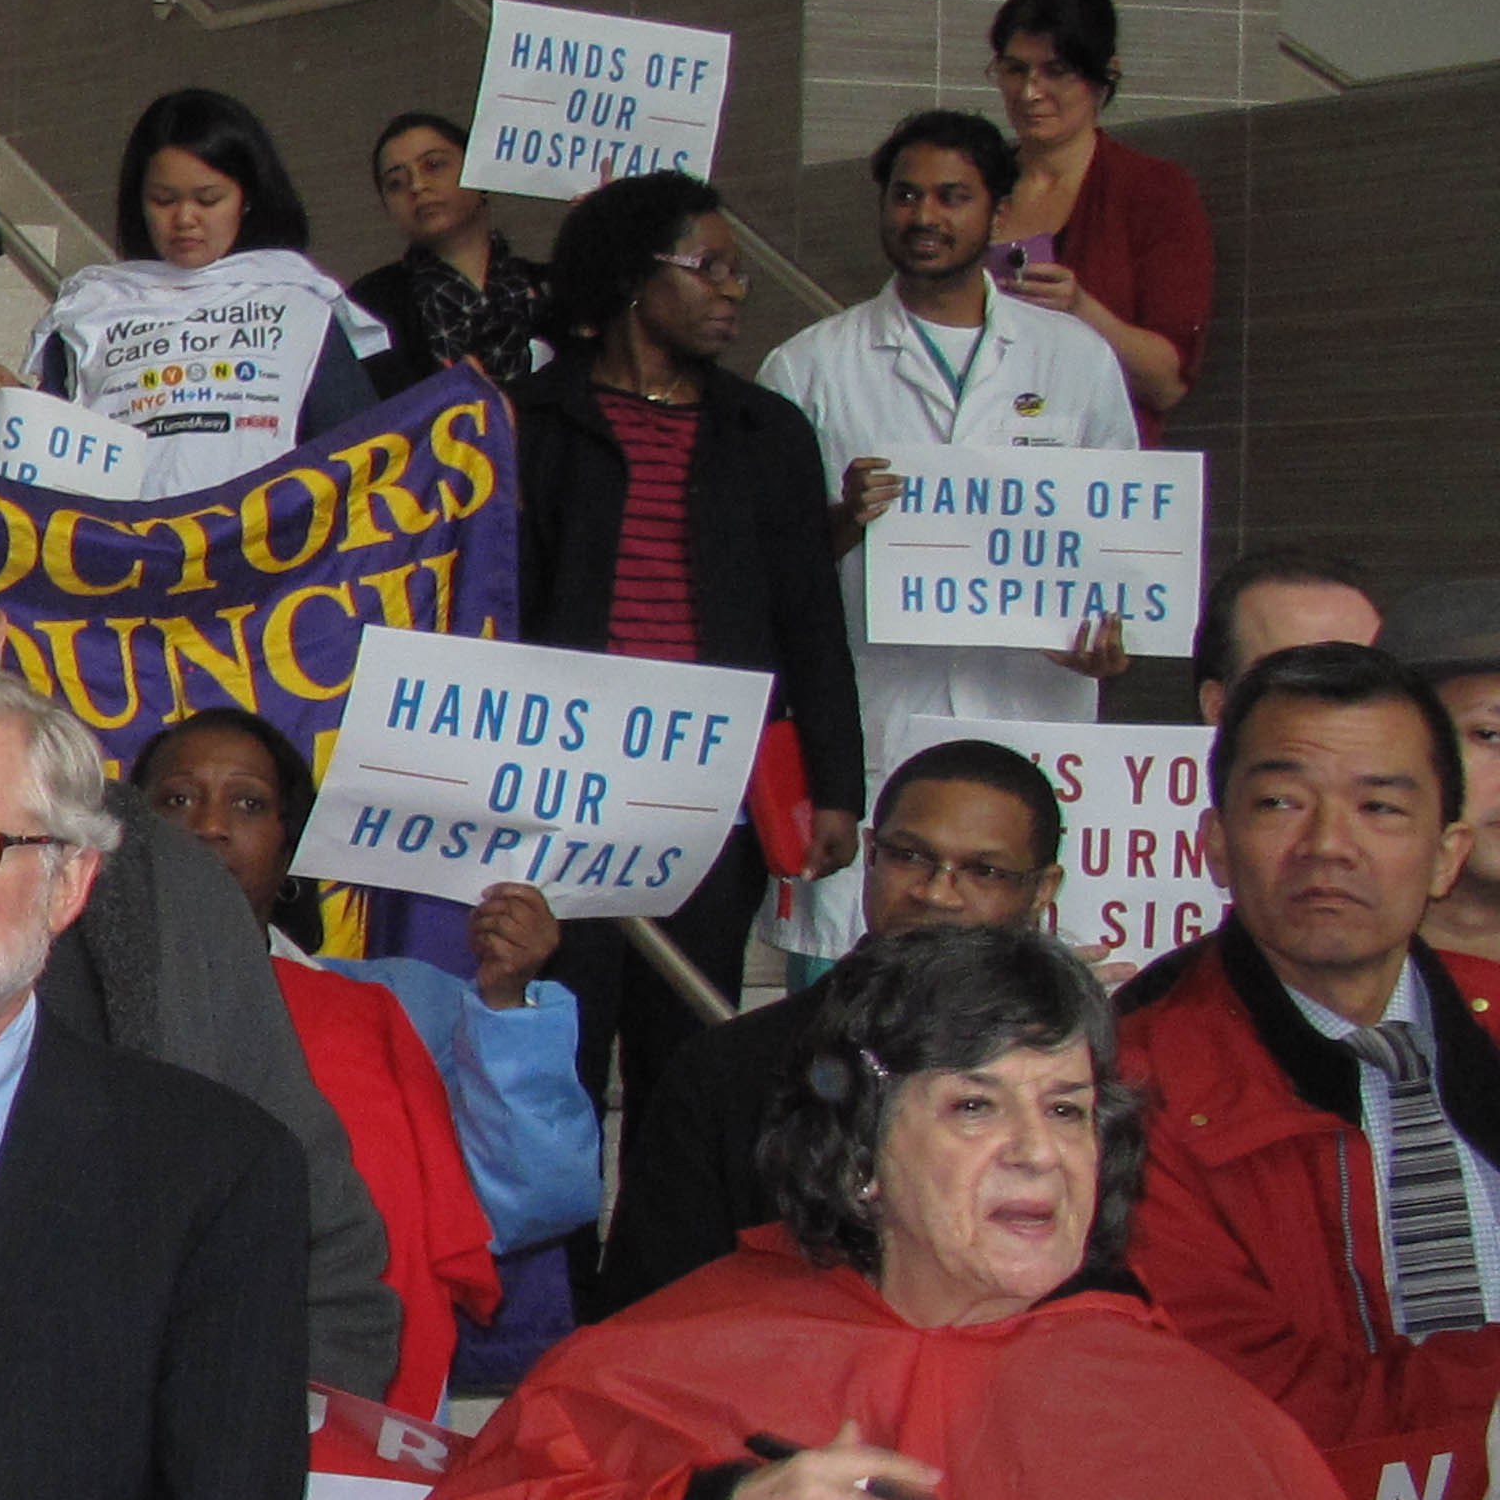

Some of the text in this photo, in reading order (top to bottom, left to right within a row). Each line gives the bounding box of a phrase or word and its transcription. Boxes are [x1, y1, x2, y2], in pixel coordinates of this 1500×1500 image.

[511, 32, 709, 94] HANDS OFF
[566, 89, 637, 131] OUR
[105, 327, 283, 367] Care for All?
[131, 393, 166, 412] NYC
[49, 425, 123, 473] OFF
[900, 475, 1175, 520] HANDS OFF
[987, 528, 1082, 568] OUR
[901, 576, 1168, 621] HOSPITALS
[387, 677, 729, 765] HANDS OFF
[487, 763, 608, 825] OUR
[349, 806, 682, 888] HOSPITALS
[1100, 901, 1233, 950] SIG
